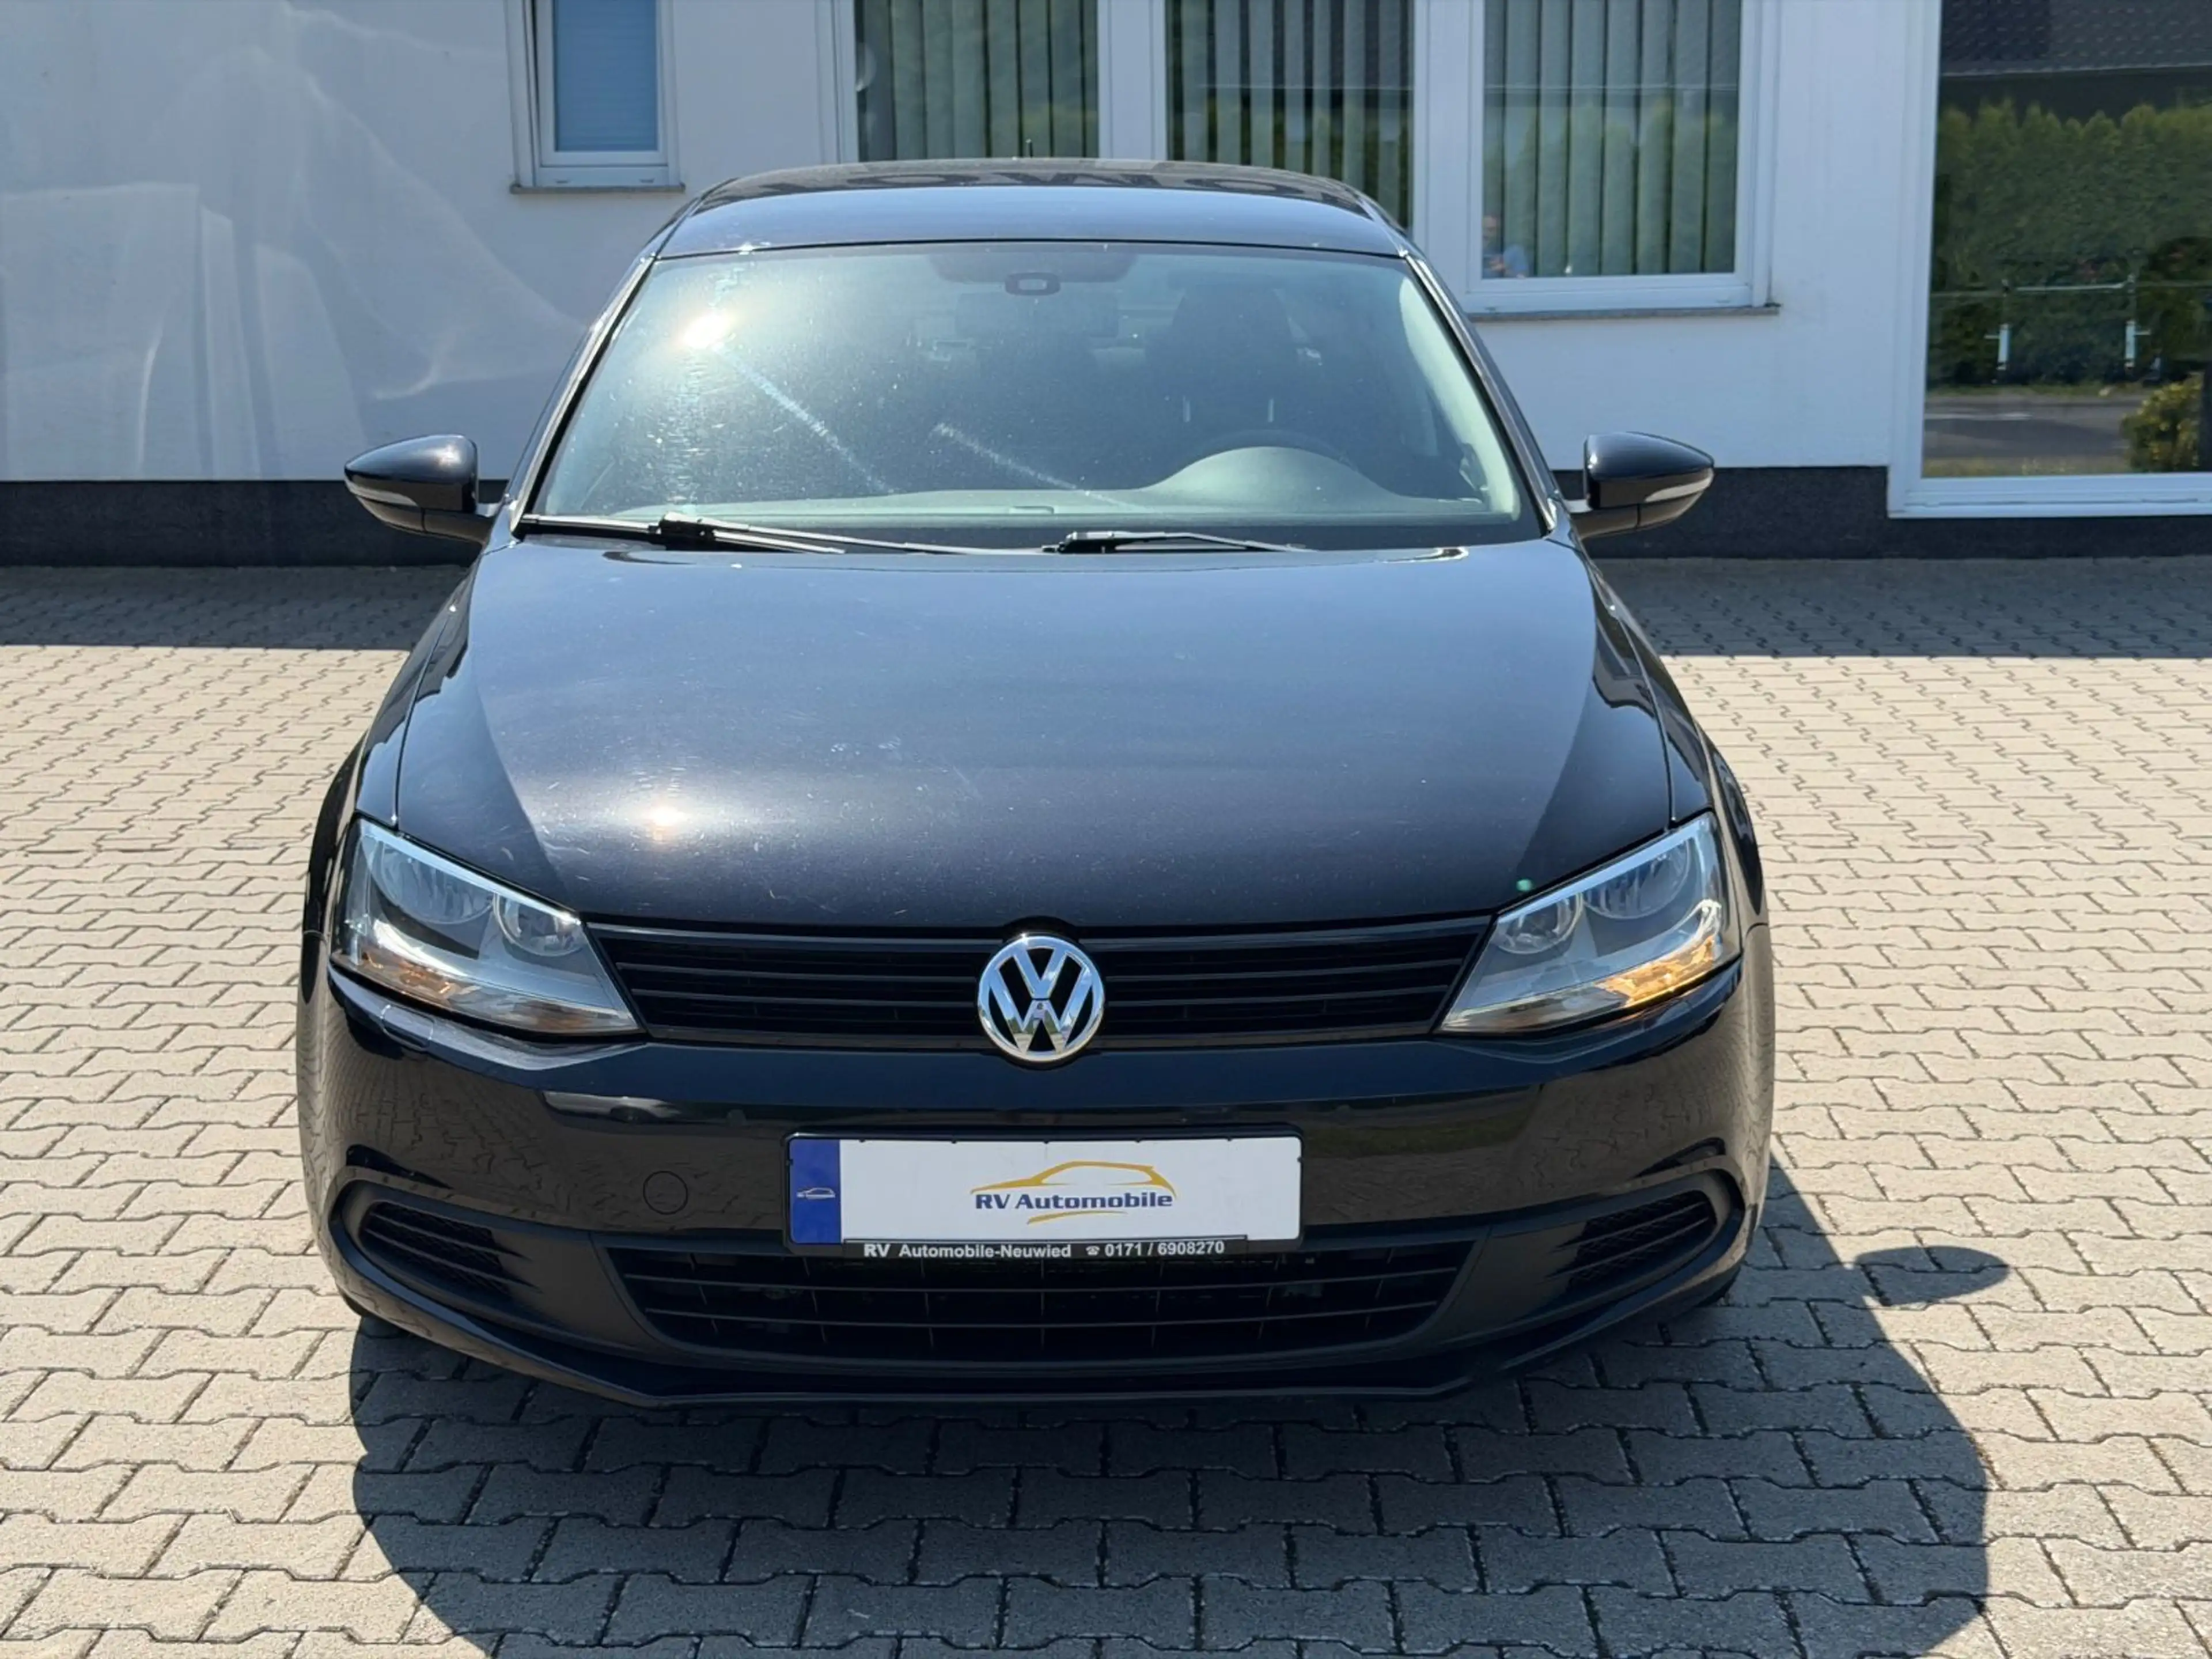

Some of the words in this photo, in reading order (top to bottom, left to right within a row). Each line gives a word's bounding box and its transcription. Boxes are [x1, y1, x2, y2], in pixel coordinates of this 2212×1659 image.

[978, 935, 1104, 1062] VW
[975, 1194, 1011, 1209] RV
[1015, 1191, 1173, 1209] Automobile
[863, 1243, 891, 1257] RV
[899, 1244, 1072, 1258] Automobile-Neuwied
[1104, 1243, 1142, 1257] 0171
[1157, 1240, 1225, 1256] 6908270
